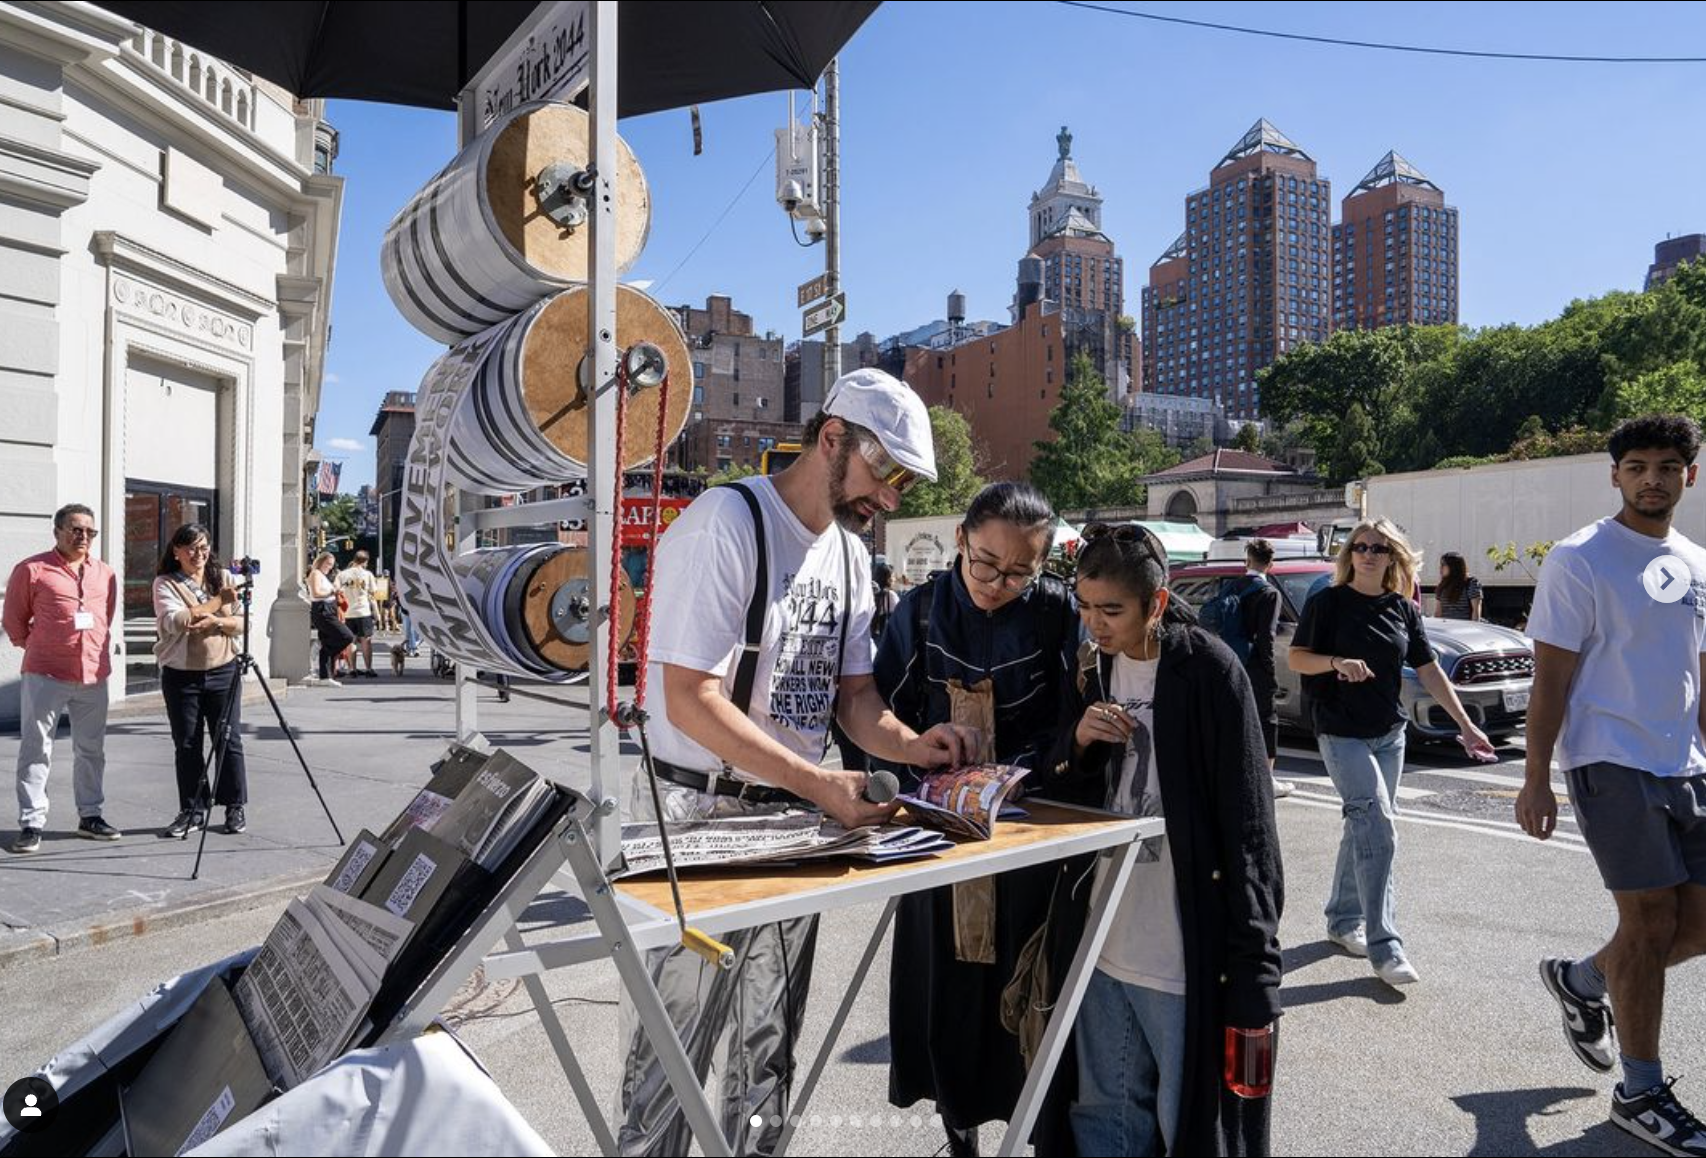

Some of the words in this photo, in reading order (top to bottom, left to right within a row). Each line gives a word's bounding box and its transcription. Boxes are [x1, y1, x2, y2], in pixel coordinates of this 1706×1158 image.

[553, 11, 584, 74] 2044
[806, 313, 818, 329] ONE
[809, 660, 835, 676] NEW
[808, 677, 831, 691] WON
[771, 692, 792, 714] THE
[795, 693, 829, 714] RIGHT
